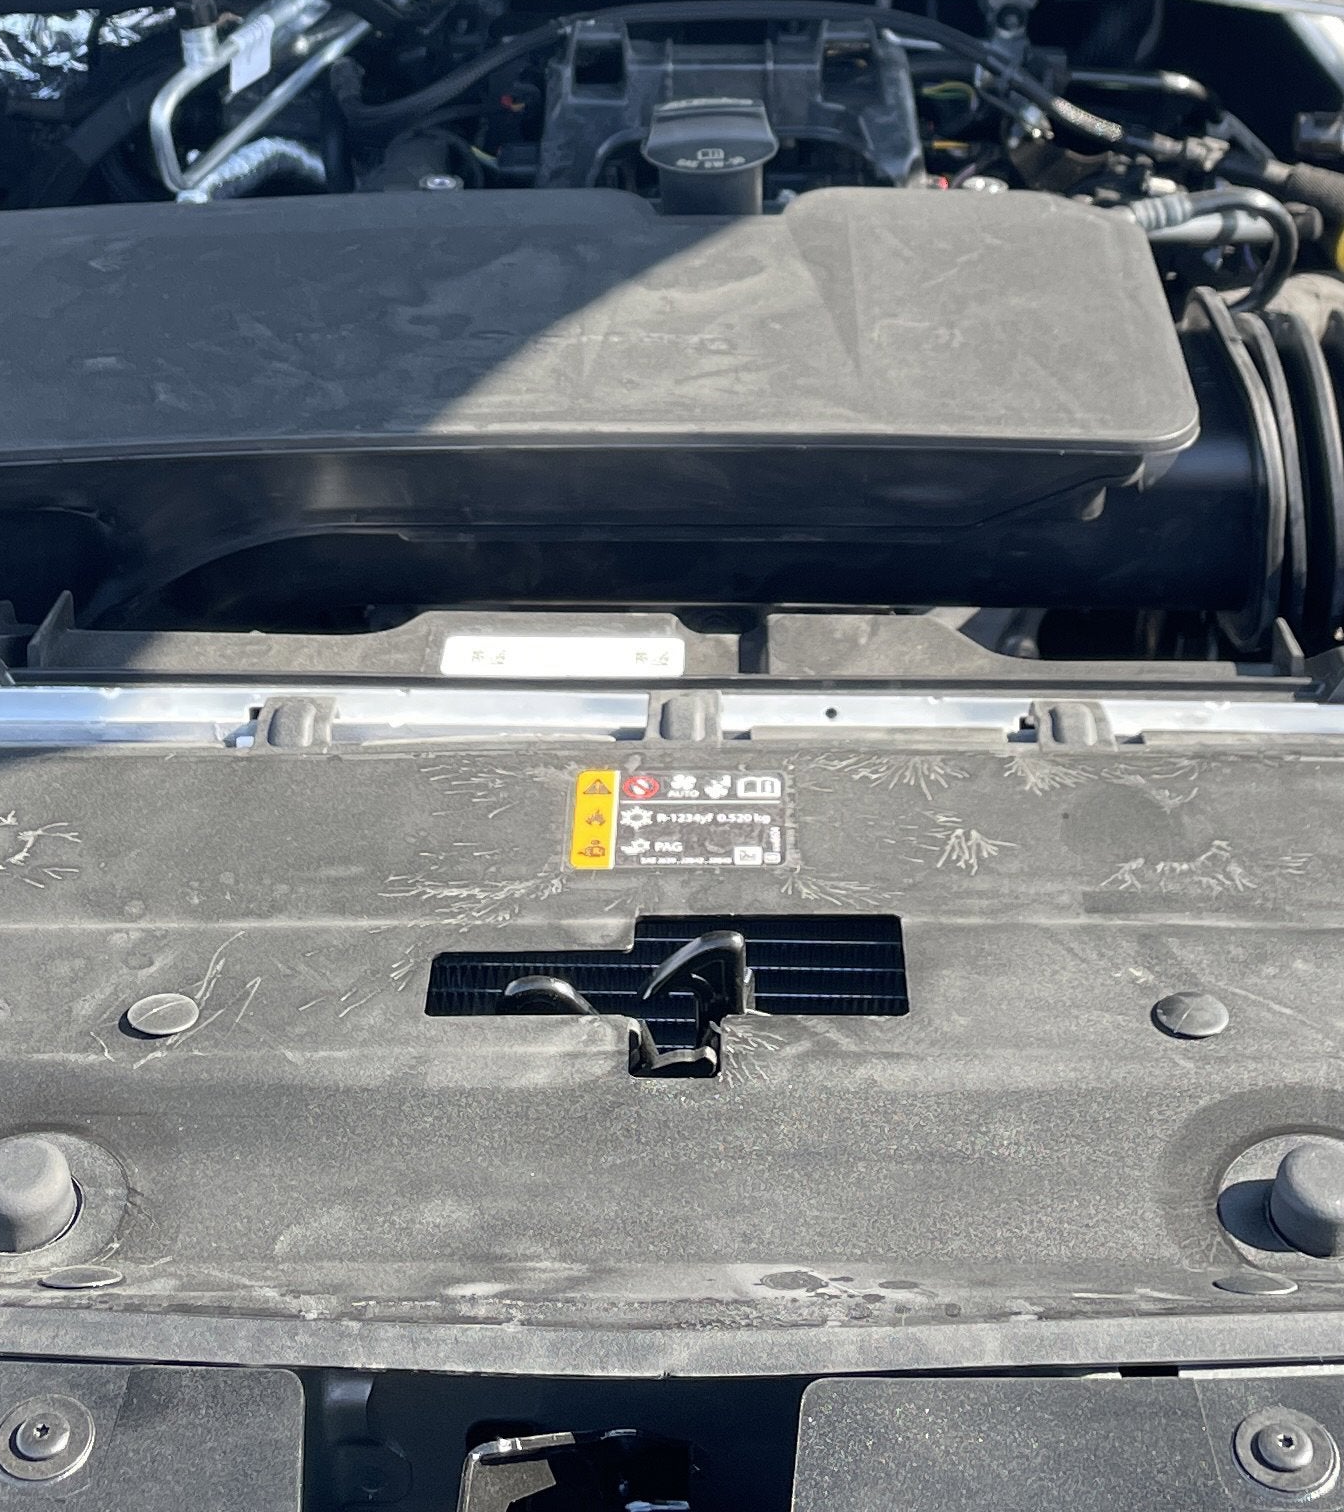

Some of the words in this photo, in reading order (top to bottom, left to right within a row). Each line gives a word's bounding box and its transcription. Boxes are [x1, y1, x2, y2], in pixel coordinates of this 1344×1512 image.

[667, 789, 699, 798] AUTO
[656, 813, 714, 825] R-1234yf
[716, 813, 752, 824] 0.520
[753, 813, 771, 825] kg
[654, 841, 683, 852] PAG
